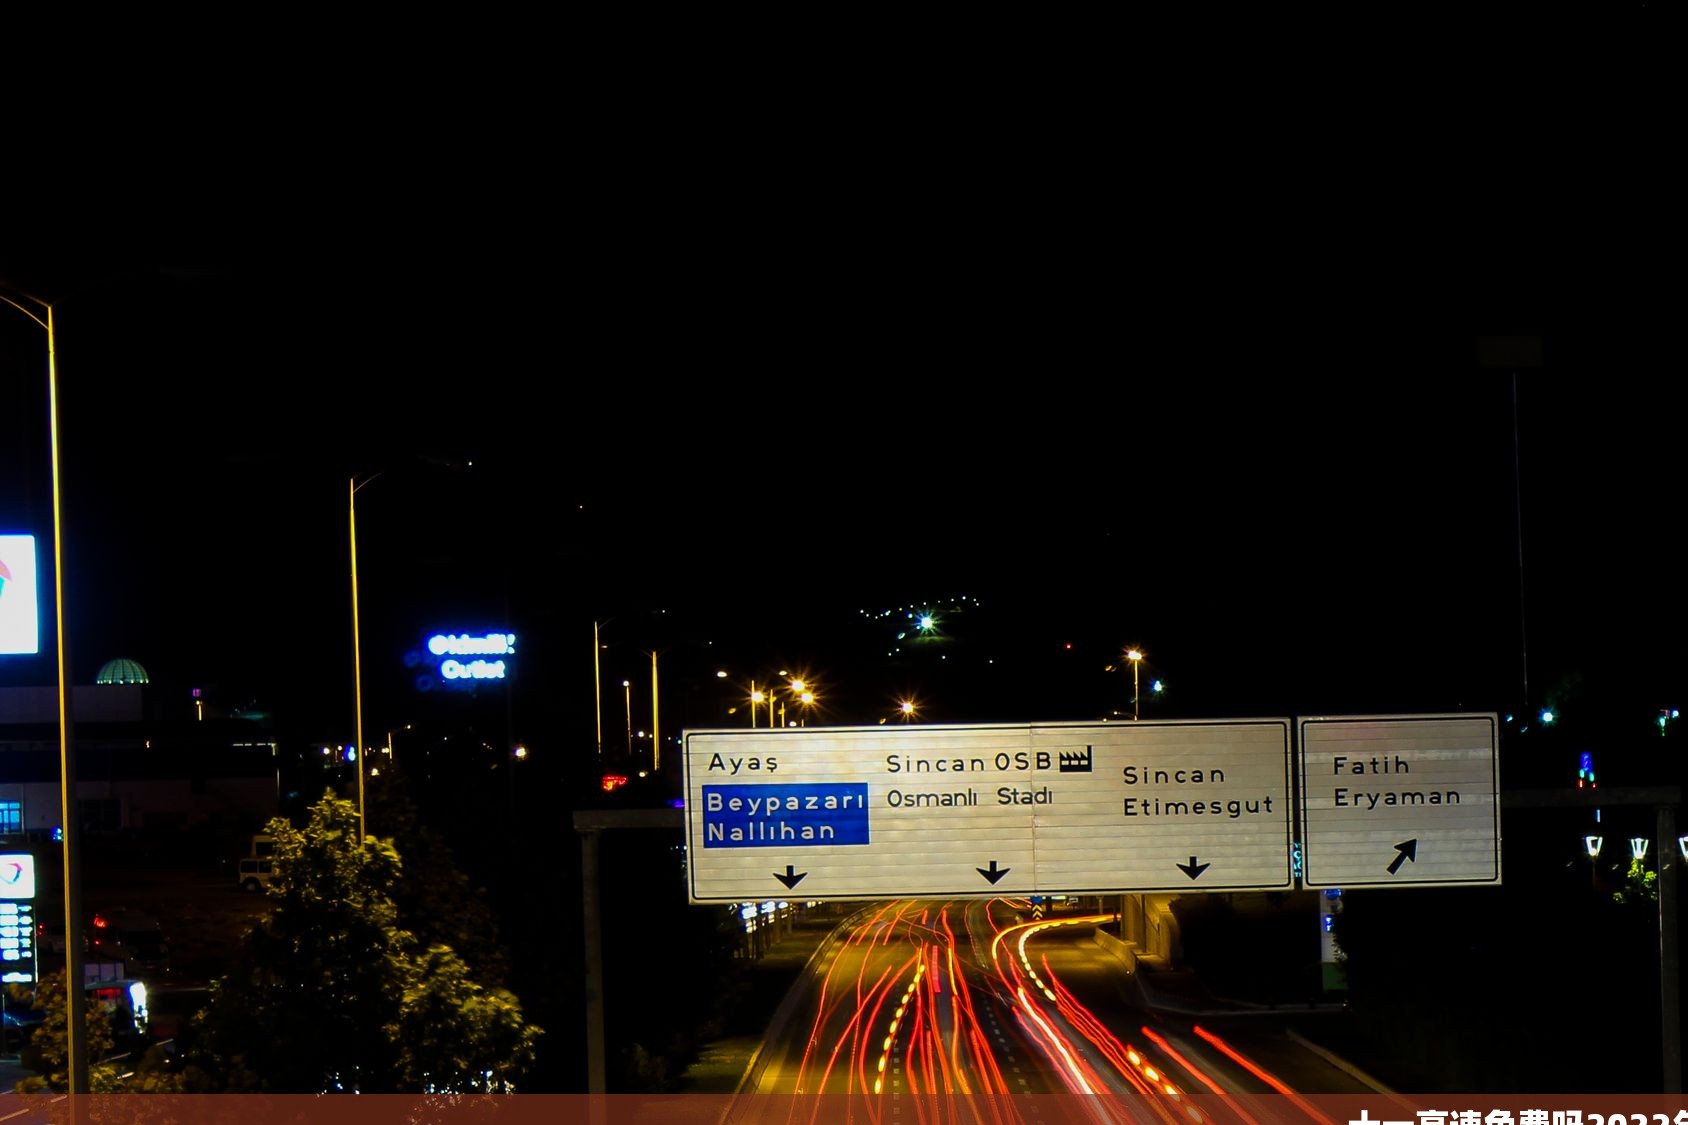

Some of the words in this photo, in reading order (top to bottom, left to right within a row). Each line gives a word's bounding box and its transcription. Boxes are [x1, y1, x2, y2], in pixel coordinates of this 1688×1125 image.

[708, 752, 778, 775] Ayaş
[886, 755, 985, 773] Sincan
[995, 751, 1052, 771] OSB
[1333, 756, 1410, 776] Fatih
[1123, 766, 1226, 785] Sincan
[707, 793, 864, 815] Beypazarı
[887, 788, 978, 808] Osmanlı
[997, 786, 1053, 806] Stadı
[1123, 795, 1274, 818] Etimesgut
[1334, 787, 1461, 811] Eryaman
[708, 821, 835, 841] Nallıhan
